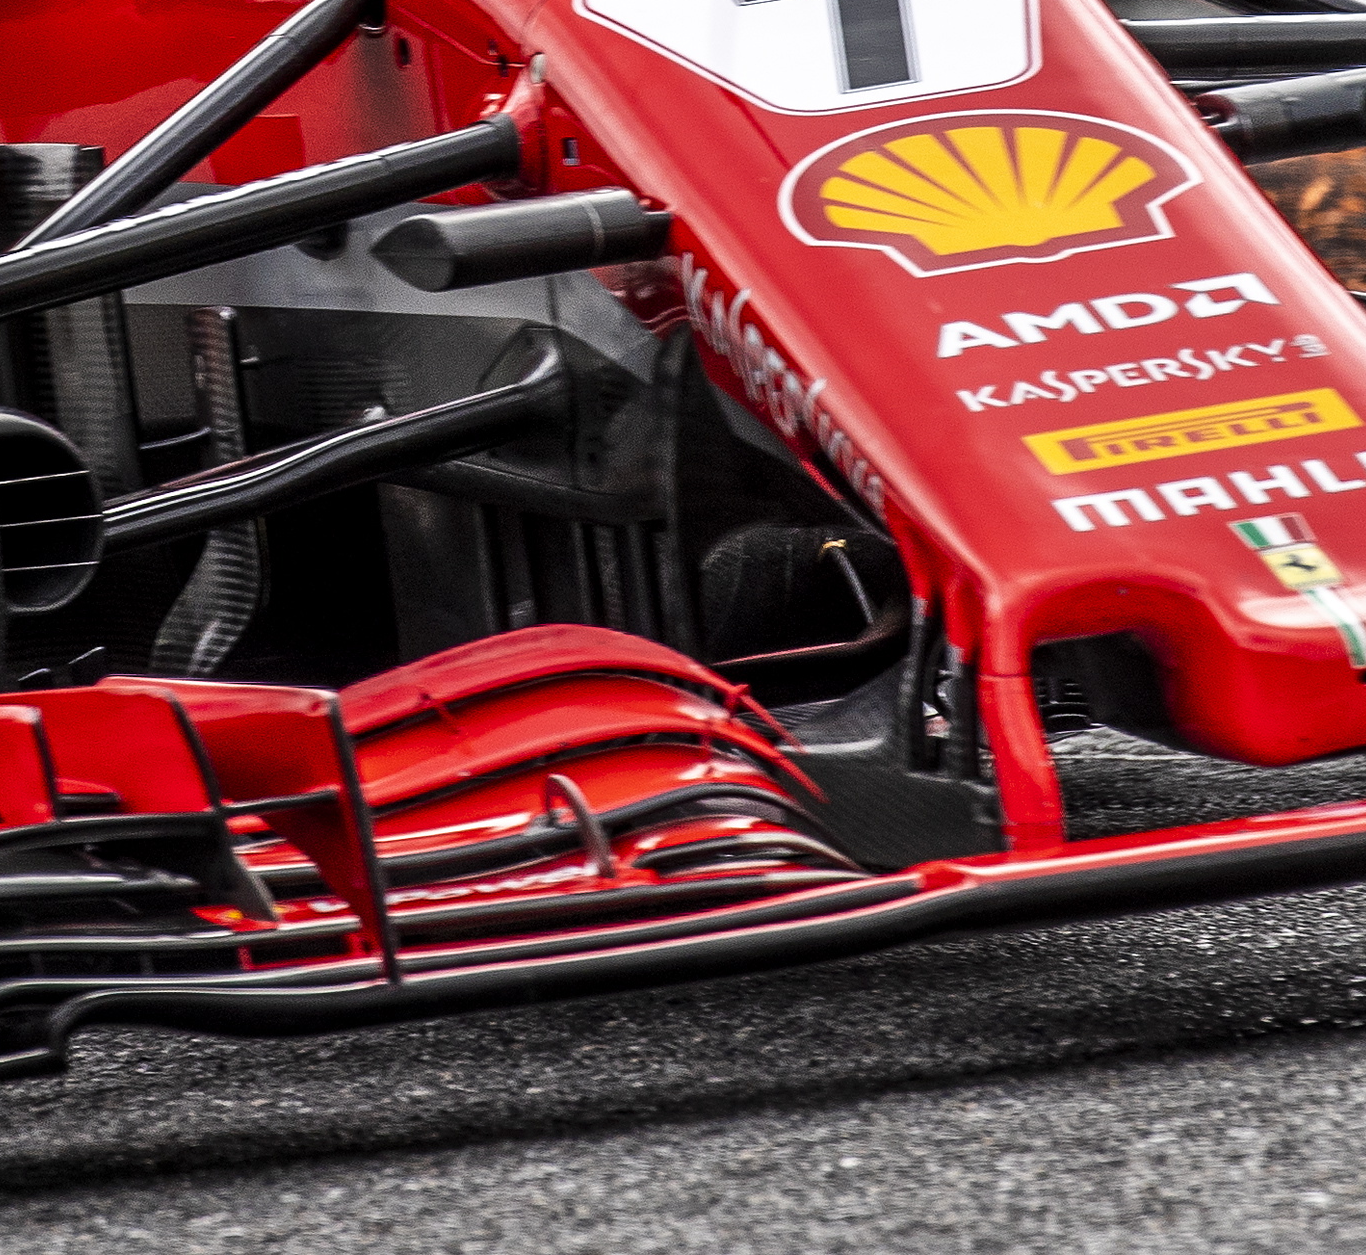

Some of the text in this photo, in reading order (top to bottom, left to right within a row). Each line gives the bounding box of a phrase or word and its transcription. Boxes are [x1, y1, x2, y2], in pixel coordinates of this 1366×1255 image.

[936, 290, 1181, 359] AMD
[955, 338, 1288, 413] KASPERSKY
[1056, 401, 1326, 461] PIRELLI
